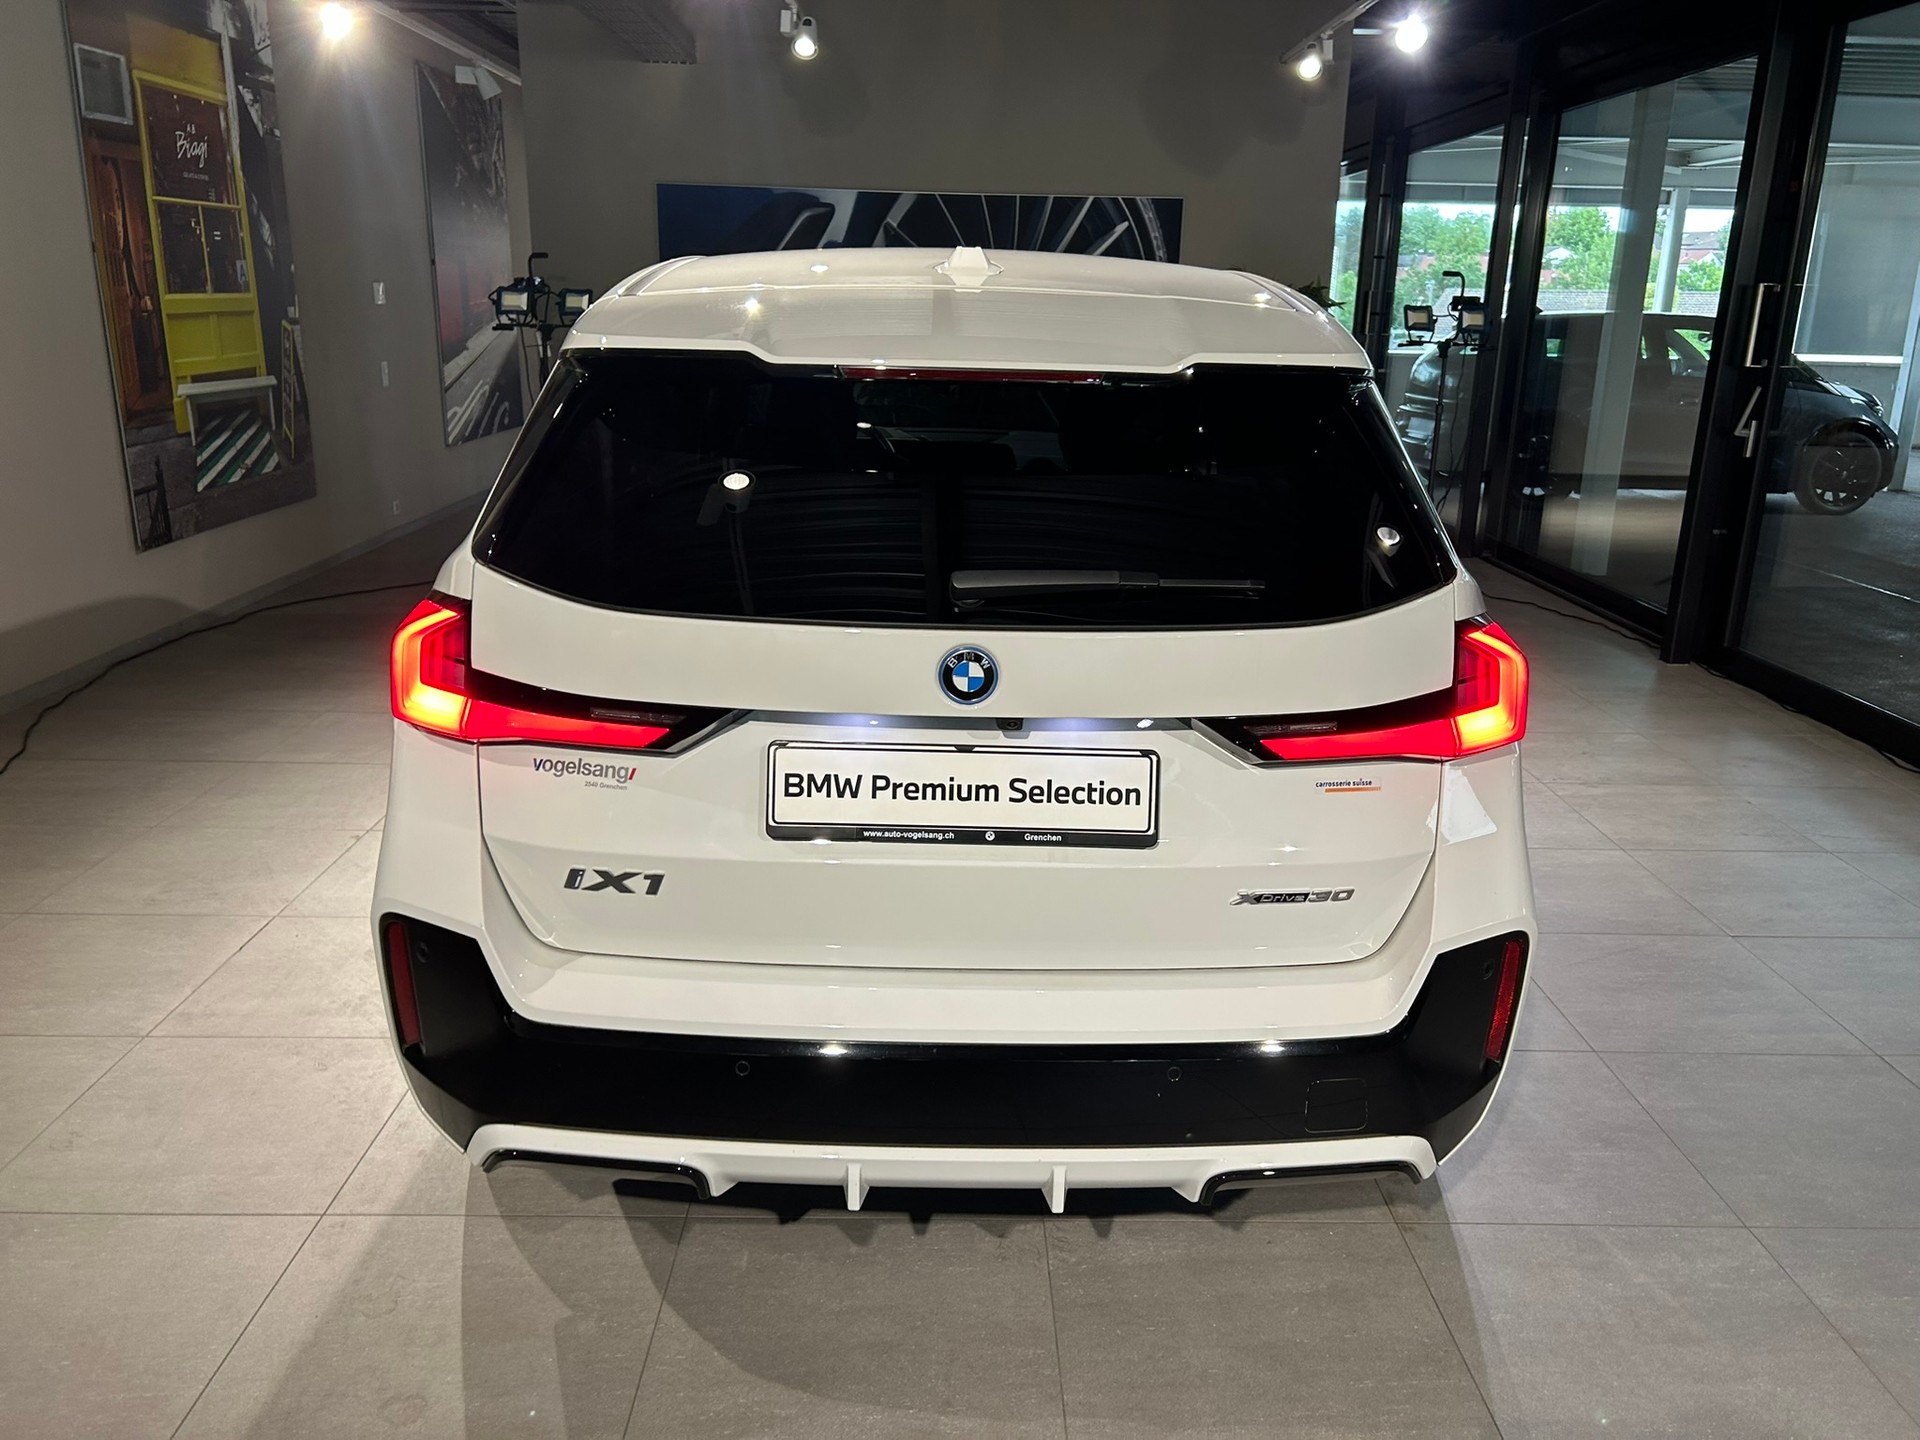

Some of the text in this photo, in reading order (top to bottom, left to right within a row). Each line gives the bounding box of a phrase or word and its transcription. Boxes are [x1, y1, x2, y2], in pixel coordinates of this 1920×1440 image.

[175, 131, 208, 168] Biagi
[947, 652, 991, 669] BMW
[783, 773, 1142, 806] BMW Premium Selection
[1315, 778, 1372, 788] carrosserie suisse
[863, 830, 1062, 842] www.auto-vogelsang.ch Grenchen
[563, 868, 666, 896] iX1
